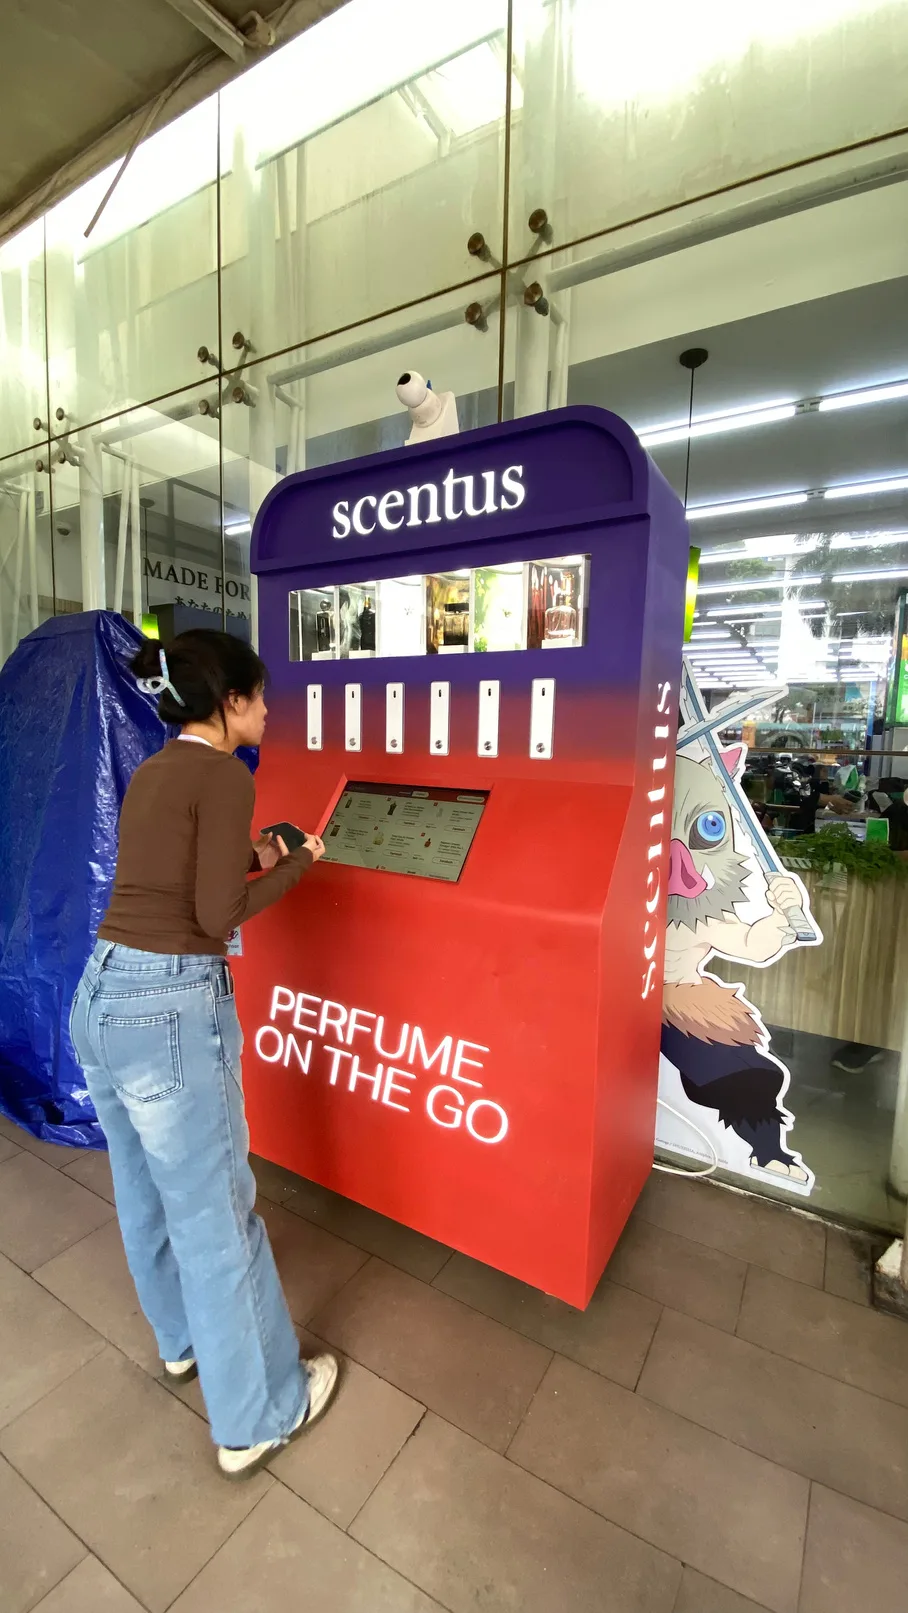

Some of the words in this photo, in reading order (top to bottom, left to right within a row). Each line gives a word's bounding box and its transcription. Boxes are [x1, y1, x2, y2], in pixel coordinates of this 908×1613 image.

[332, 465, 525, 539] scentus
[143, 557, 208, 590] MADE
[214, 576, 251, 601] FOR
[641, 681, 671, 999] scentus
[255, 1026, 312, 1075] ON
[323, 1045, 416, 1113] THE
[426, 1084, 508, 1143] GO
[270, 985, 490, 1088] PERFUME
